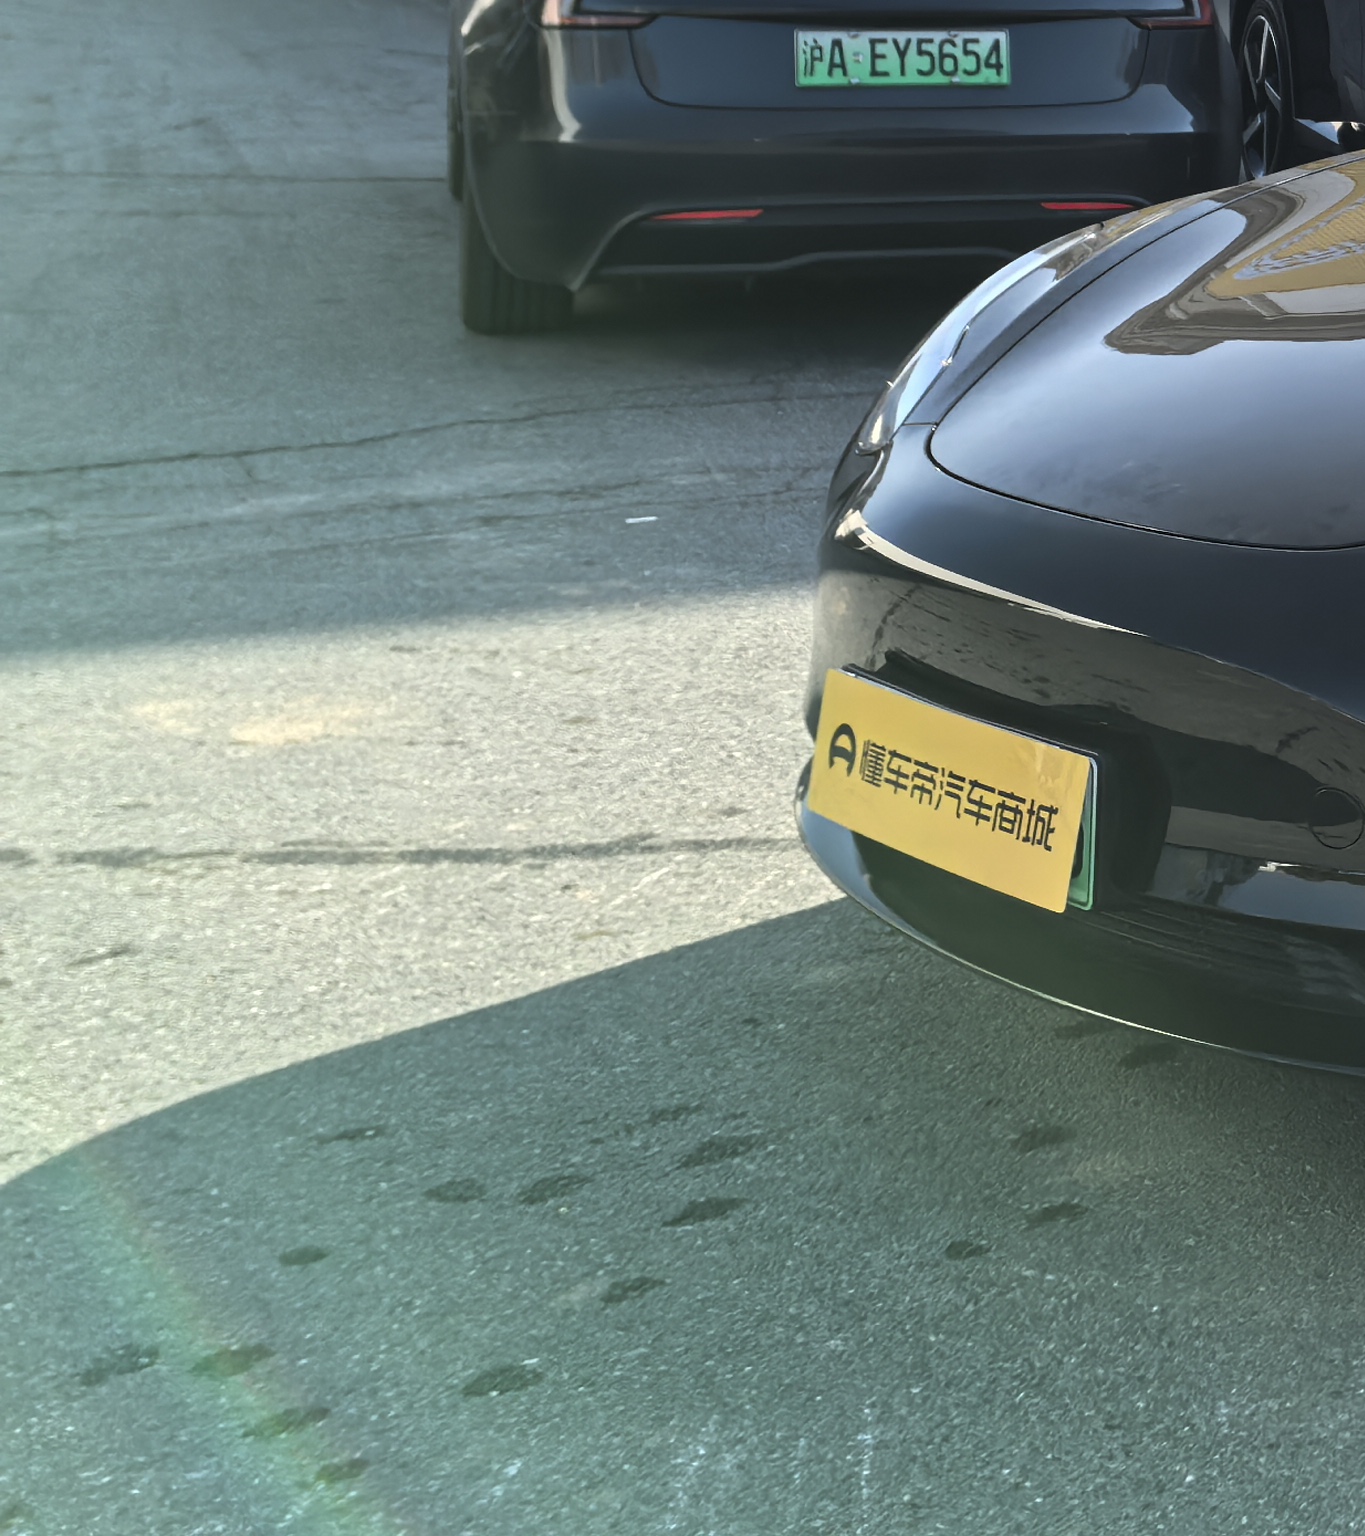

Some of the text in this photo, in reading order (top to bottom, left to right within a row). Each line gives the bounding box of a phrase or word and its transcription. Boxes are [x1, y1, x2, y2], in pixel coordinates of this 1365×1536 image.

[859, 738, 1060, 853] 懂车帝汽车商城
